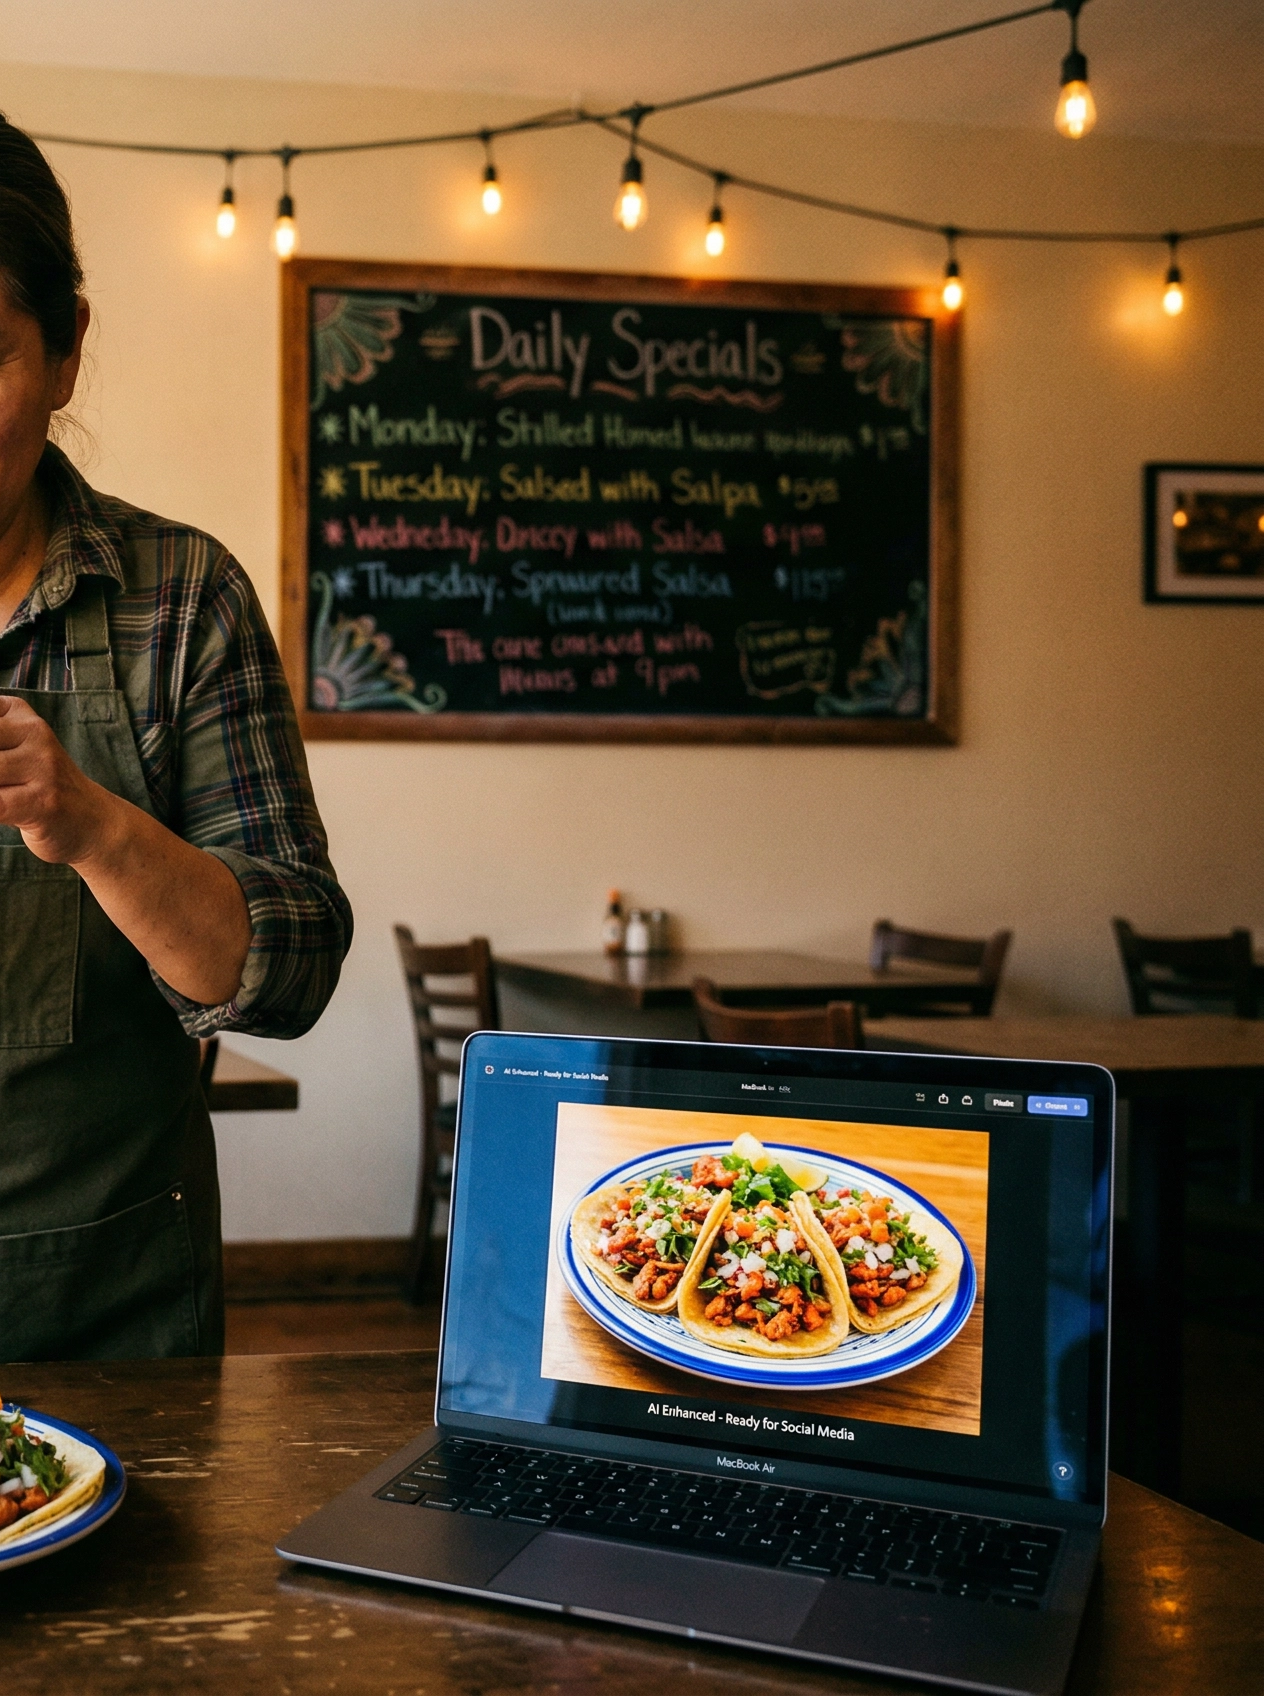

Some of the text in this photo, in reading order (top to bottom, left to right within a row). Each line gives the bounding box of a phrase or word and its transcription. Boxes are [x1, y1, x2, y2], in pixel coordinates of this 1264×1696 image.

[469, 305, 784, 399] Daily Specials
[598, 468, 662, 503] with
[586, 518, 644, 551] with
[651, 516, 727, 554] Salsa
[651, 560, 734, 599] Salsa
[647, 1402, 659, 1415] AI
[662, 1404, 716, 1423] Enhanced
[725, 1412, 760, 1432] Ready
[762, 1416, 780, 1431] for
[781, 1420, 815, 1436] Social
[817, 1424, 855, 1441] Media
[762, 1463, 775, 1473] Air
